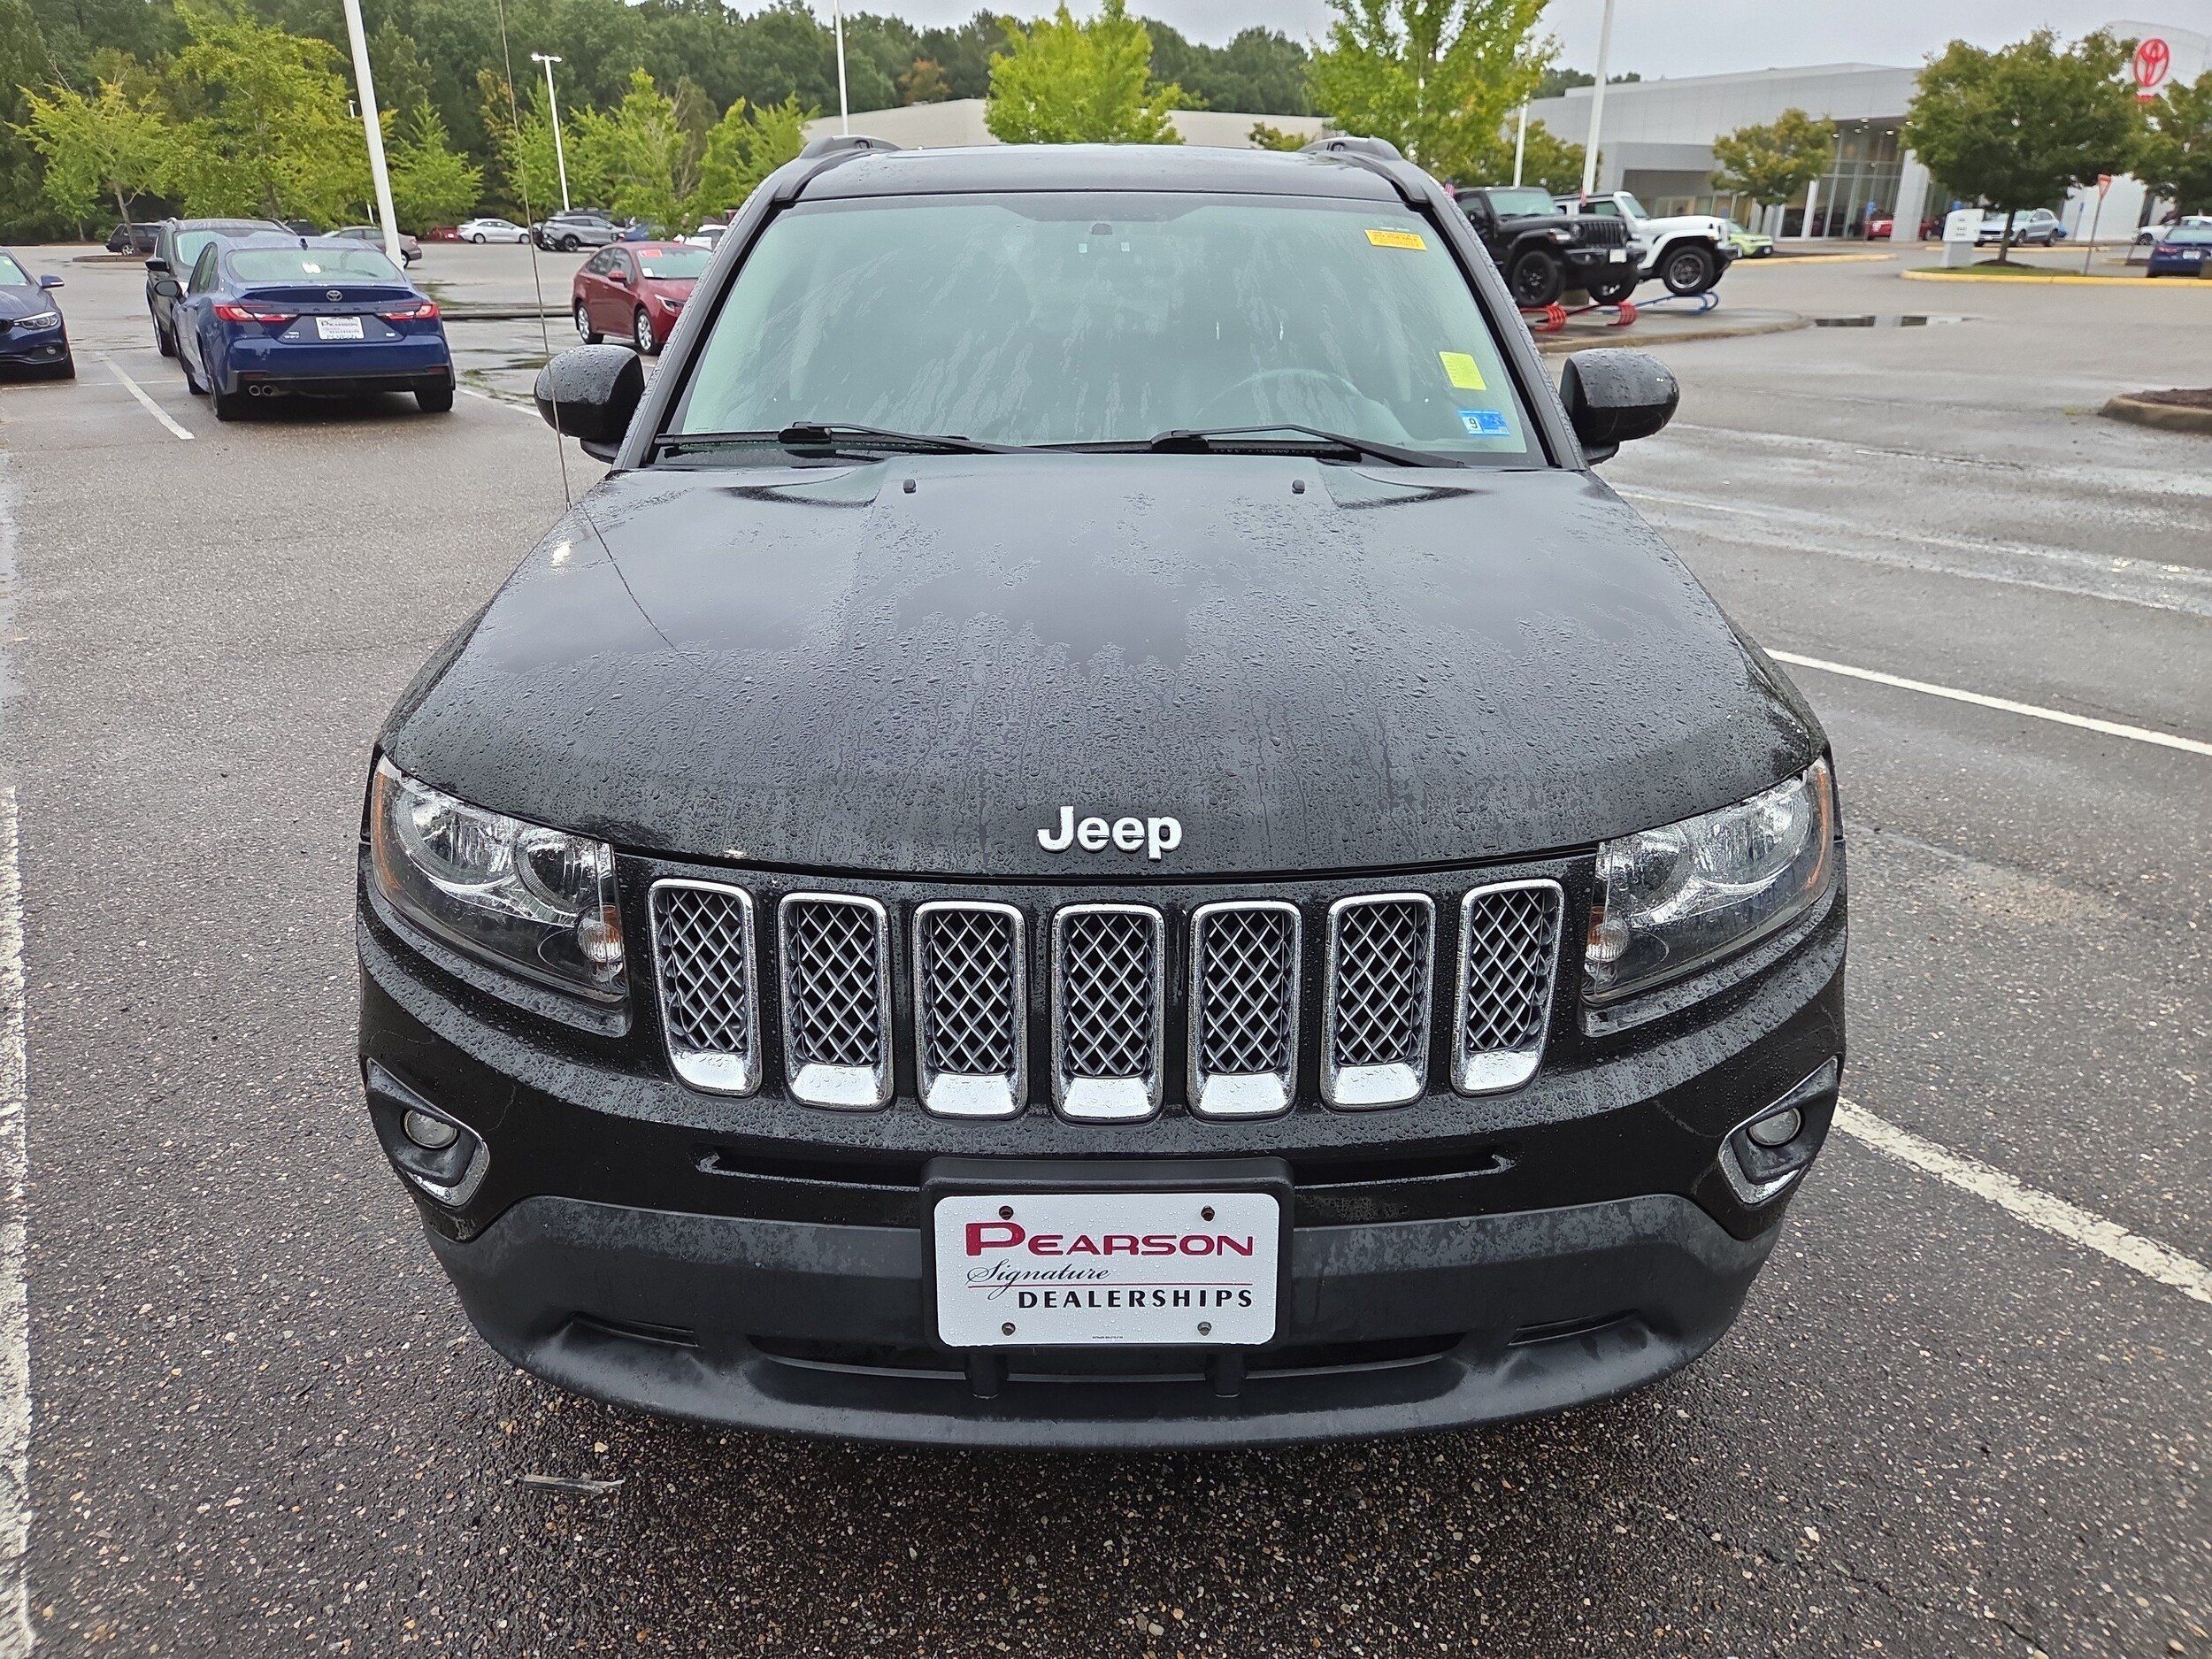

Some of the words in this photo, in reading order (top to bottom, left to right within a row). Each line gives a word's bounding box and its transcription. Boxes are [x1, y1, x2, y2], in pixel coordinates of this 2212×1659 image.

[1469, 418, 1478, 429] 9
[1037, 806, 1183, 860] Jeep
[965, 1222, 1254, 1256] PEARSON
[965, 1258, 1110, 1301] Signature
[1018, 1289, 1253, 1309] DEALERSHIPS
